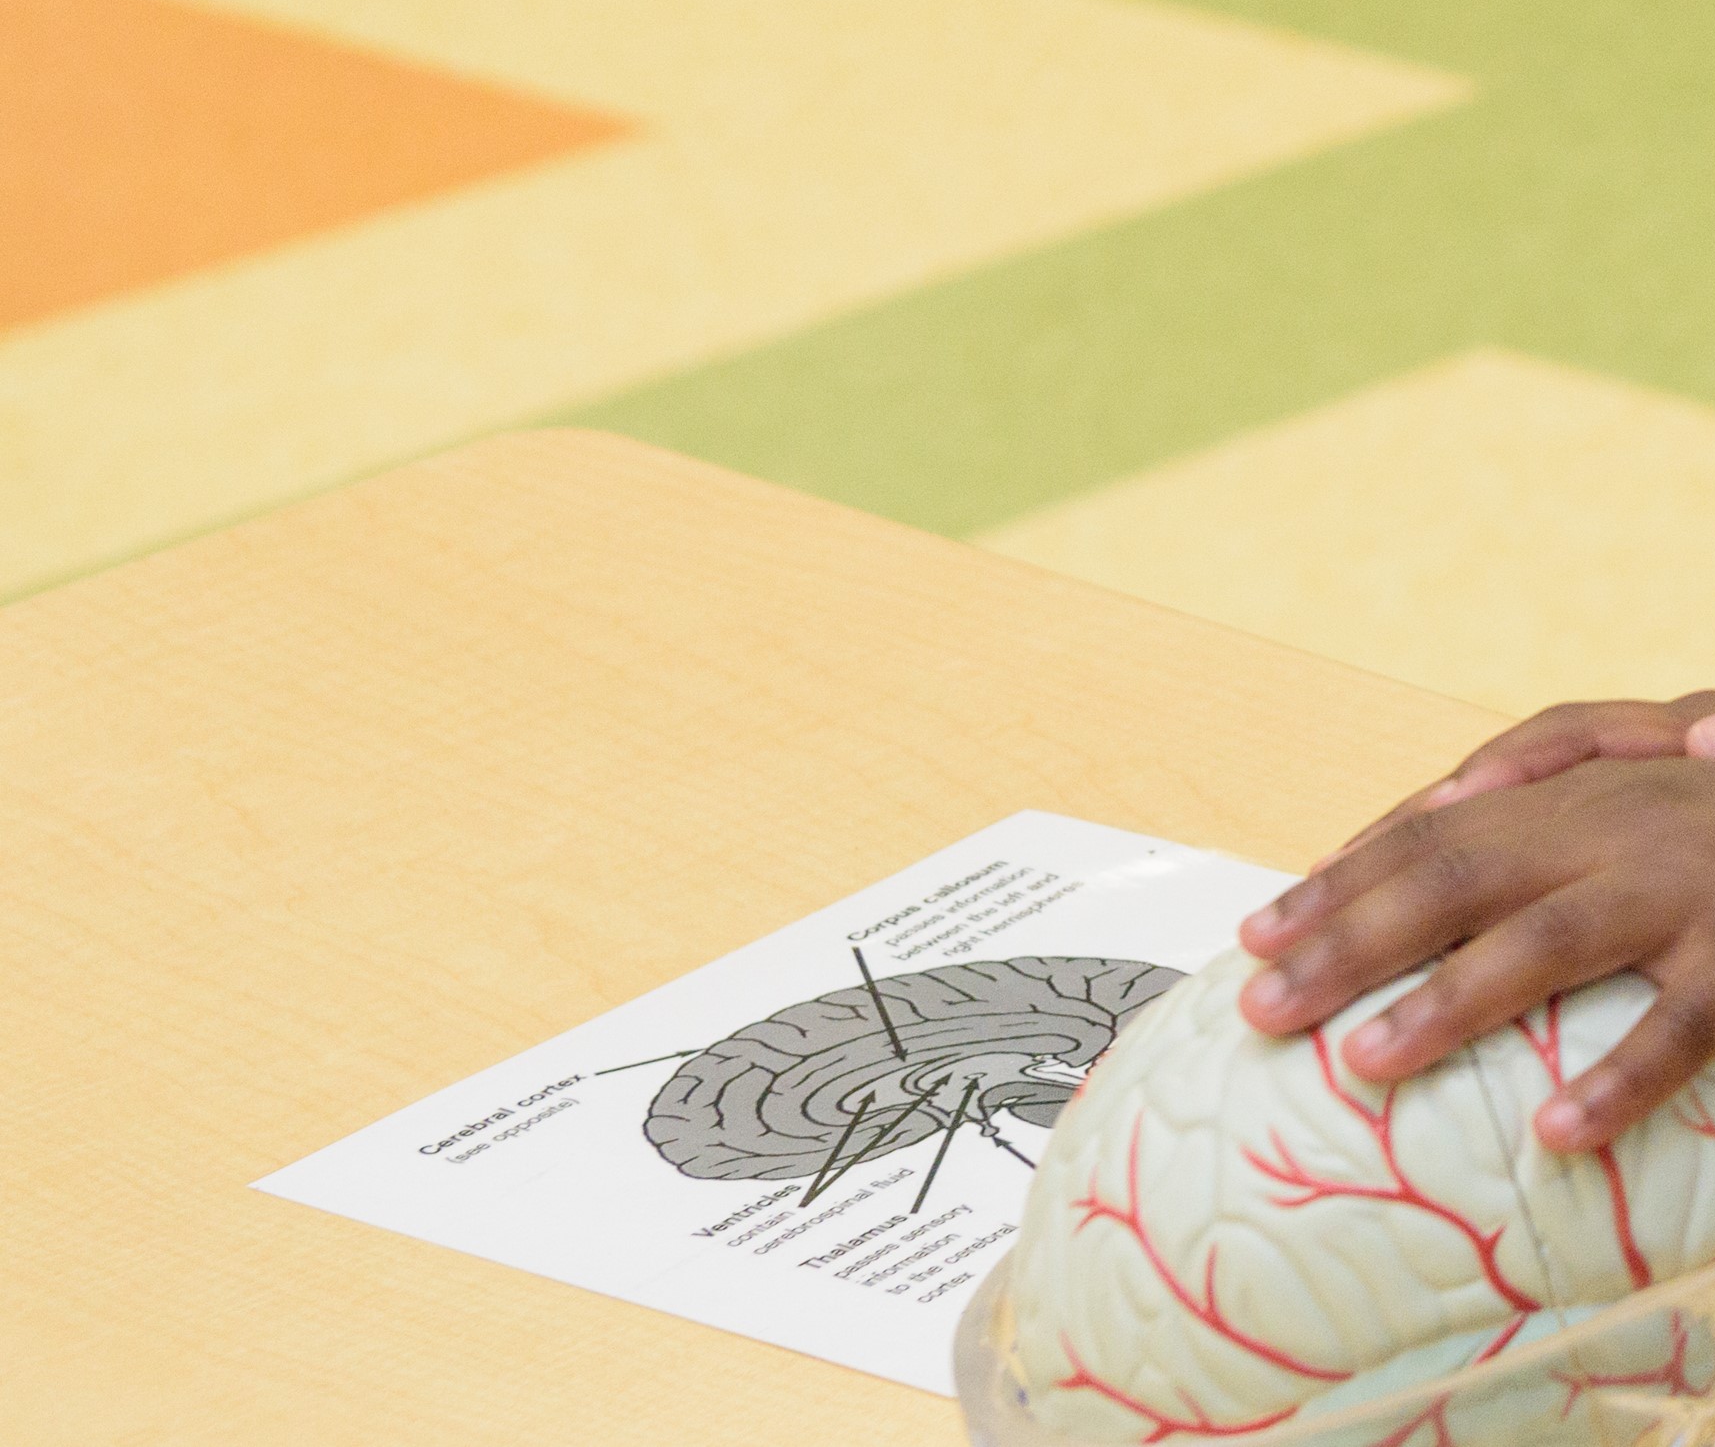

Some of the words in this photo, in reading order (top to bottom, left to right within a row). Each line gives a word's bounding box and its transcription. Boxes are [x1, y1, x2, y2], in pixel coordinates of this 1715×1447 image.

[847, 904, 921, 941] Corpus
[885, 914, 945, 947] passes
[946, 864, 1034, 914] information
[891, 922, 968, 961] between
[967, 906, 998, 923] the
[1026, 871, 1060, 891] and
[942, 935, 984, 957] right
[418, 1107, 516, 1155] Cerebral
[517, 1073, 587, 1108] cortex
[445, 1142, 491, 1164] (see
[492, 1097, 581, 1142] opposite)
[691, 1183, 802, 1238] Ventricles
[727, 1210, 795, 1248] contain
[753, 1188, 876, 1255] cerebrospinal
[870, 1167, 915, 1190] fluid
[797, 1214, 908, 1269] Thalamus
[833, 1242, 900, 1281] passes
[900, 1203, 974, 1243] sensory
[856, 1232, 961, 1287] information
[885, 1283, 911, 1296] to
[908, 1264, 944, 1283] the
[944, 1222, 1020, 1265] cerebral
[917, 1271, 976, 1304] cortex
